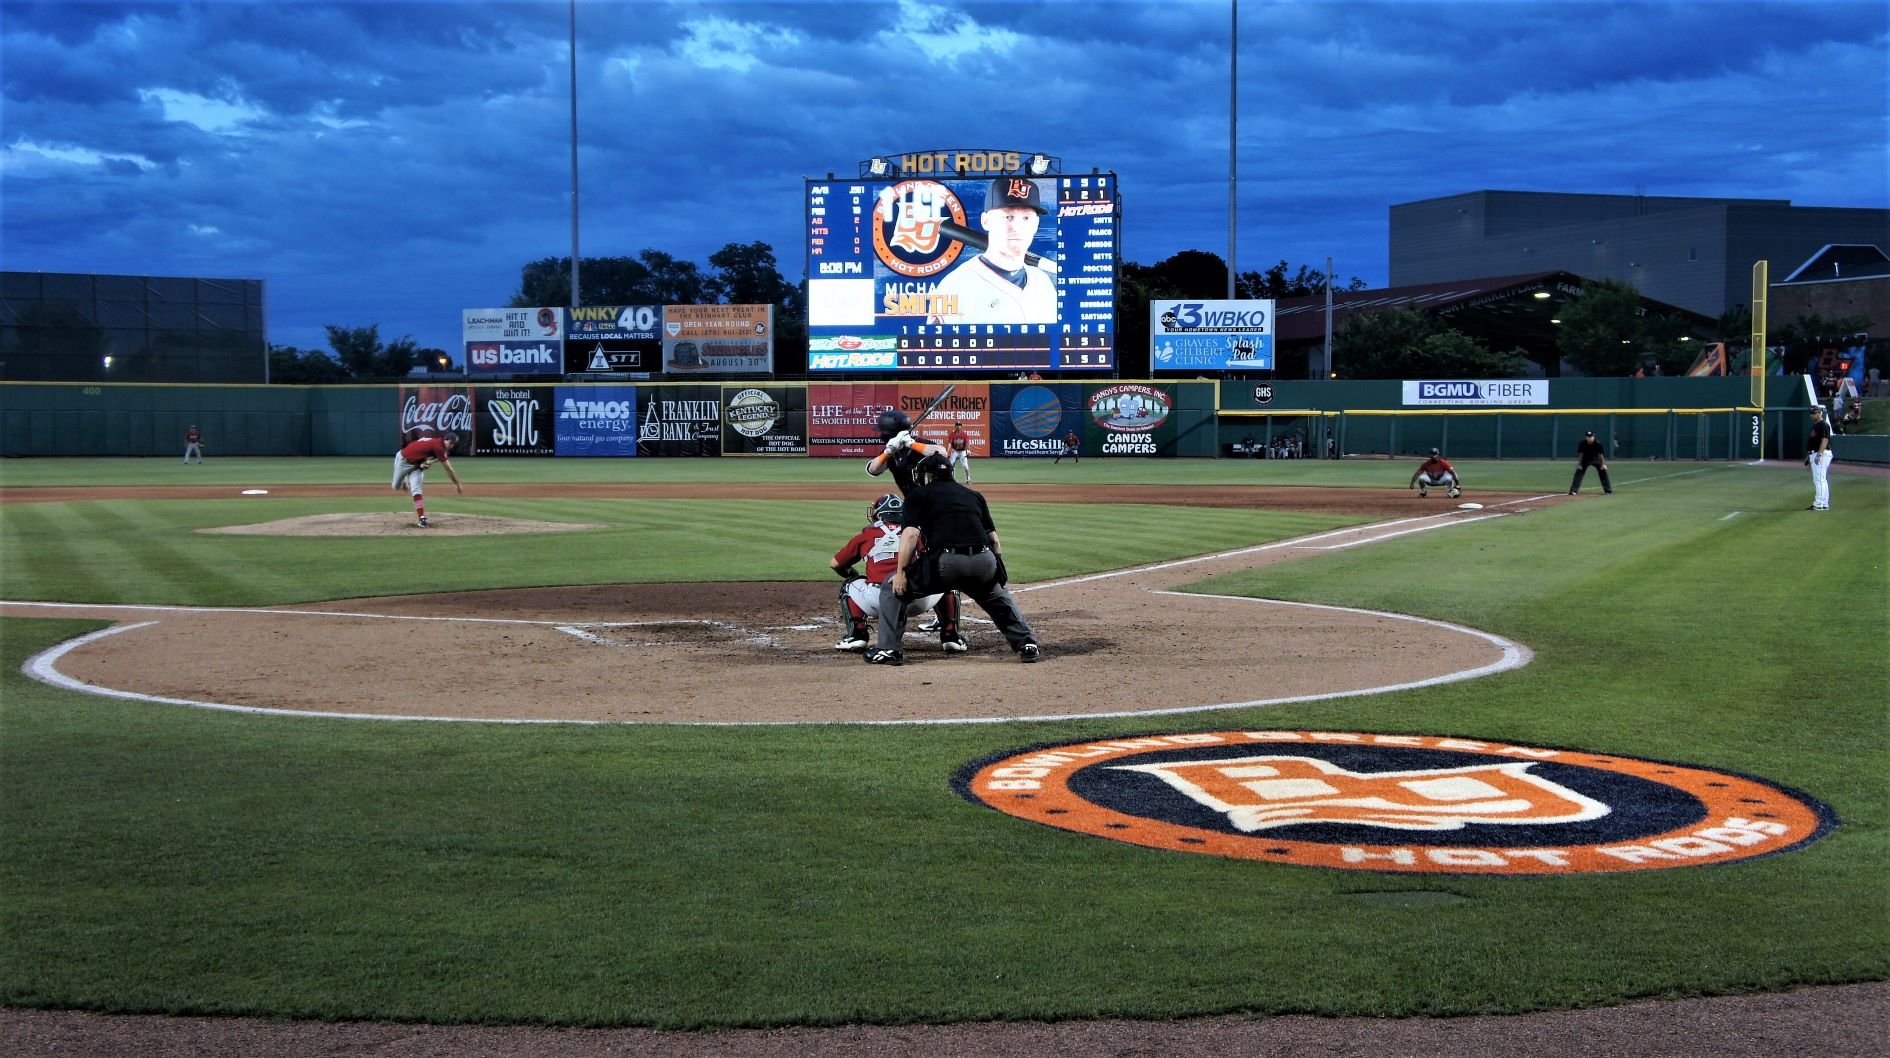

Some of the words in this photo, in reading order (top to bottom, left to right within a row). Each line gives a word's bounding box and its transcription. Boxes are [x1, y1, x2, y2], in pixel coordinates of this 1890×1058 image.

[902, 154, 948, 173] HOT
[955, 152, 1020, 172] RODS
[844, 262, 862, 273] PM
[891, 259, 915, 272] HOT
[917, 258, 948, 273] RODS
[883, 294, 959, 315] SMITH
[506, 312, 518, 321] HIT
[569, 307, 618, 321] WNKY
[617, 306, 654, 331] 40
[1170, 304, 1204, 327] 13
[1204, 311, 1265, 327] WBKO
[509, 321, 525, 329] AND
[918, 326, 925, 334] 2
[935, 326, 942, 334] 3
[952, 325, 959, 334] 4
[969, 325, 976, 334] 5
[986, 325, 994, 333] 6
[1003, 325, 1011, 333] 7
[1021, 325, 1028, 333] 8
[1038, 324, 1046, 333] 9
[504, 329, 518, 337] WIN
[521, 328, 531, 336] IT!
[902, 340, 908, 348] 0
[935, 339, 942, 347] 0
[952, 339, 959, 347] 0
[969, 339, 976, 347] 0
[986, 338, 994, 347] 0
[1175, 339, 1218, 347] GRAVES
[1224, 336, 1264, 352] Splash
[1175, 347, 1225, 356] GILBERT
[1233, 348, 1256, 360] Pad
[918, 356, 925, 364] 0
[935, 356, 942, 364] 0
[952, 356, 959, 364] 0
[969, 356, 976, 364] 0
[1098, 355, 1105, 363] 0
[496, 390, 509, 399] the
[510, 390, 530, 399] hotel
[738, 390, 763, 400] OFFICIAL
[1256, 387, 1271, 397] GHS
[1423, 384, 1475, 397] BGMU
[1488, 384, 1532, 397] FIBER
[560, 398, 630, 419] ATMOS
[951, 396, 987, 410] RICHEY
[402, 395, 472, 434] Coca-Cola
[662, 401, 720, 420] FRANKLIN
[729, 406, 776, 418] KENTUCKY
[812, 405, 843, 417] LIFE
[926, 411, 955, 420] SERVICE
[957, 411, 980, 420] GROUP
[580, 420, 629, 431] energy
[755, 426, 767, 435] DOG
[662, 423, 691, 440] BANK
[701, 423, 719, 432] Trust
[692, 432, 719, 440] Company
[1107, 433, 1152, 443] CANDYS
[1102, 444, 1157, 453] CAMPERS
[987, 732, 1227, 790] BOWLING
[1242, 730, 1562, 758] GREEN
[1341, 846, 1571, 866] HOT
[1595, 816, 1790, 864] RODS
